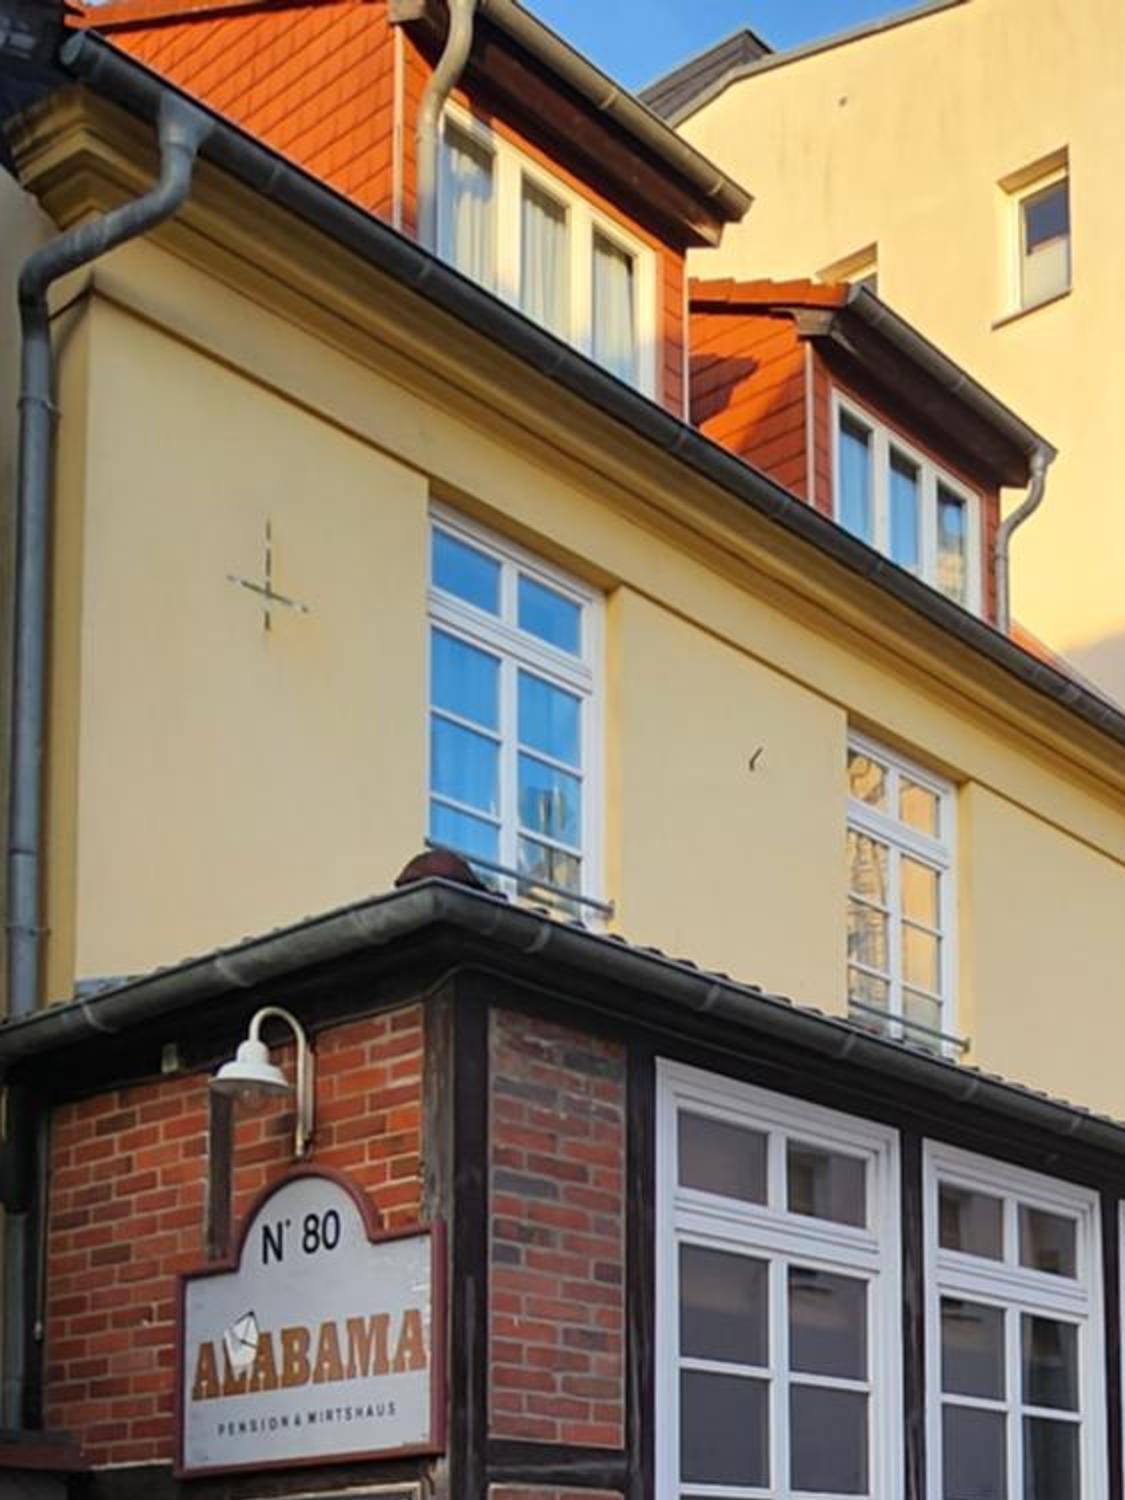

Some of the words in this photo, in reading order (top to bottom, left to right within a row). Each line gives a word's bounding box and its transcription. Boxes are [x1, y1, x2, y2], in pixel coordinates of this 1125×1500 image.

[302, 1209, 341, 1254] 80
[191, 1309, 427, 1401] ALABAMA
[217, 1415, 289, 1436] PENSION
[307, 1401, 396, 1424] WIRTSHAUS
